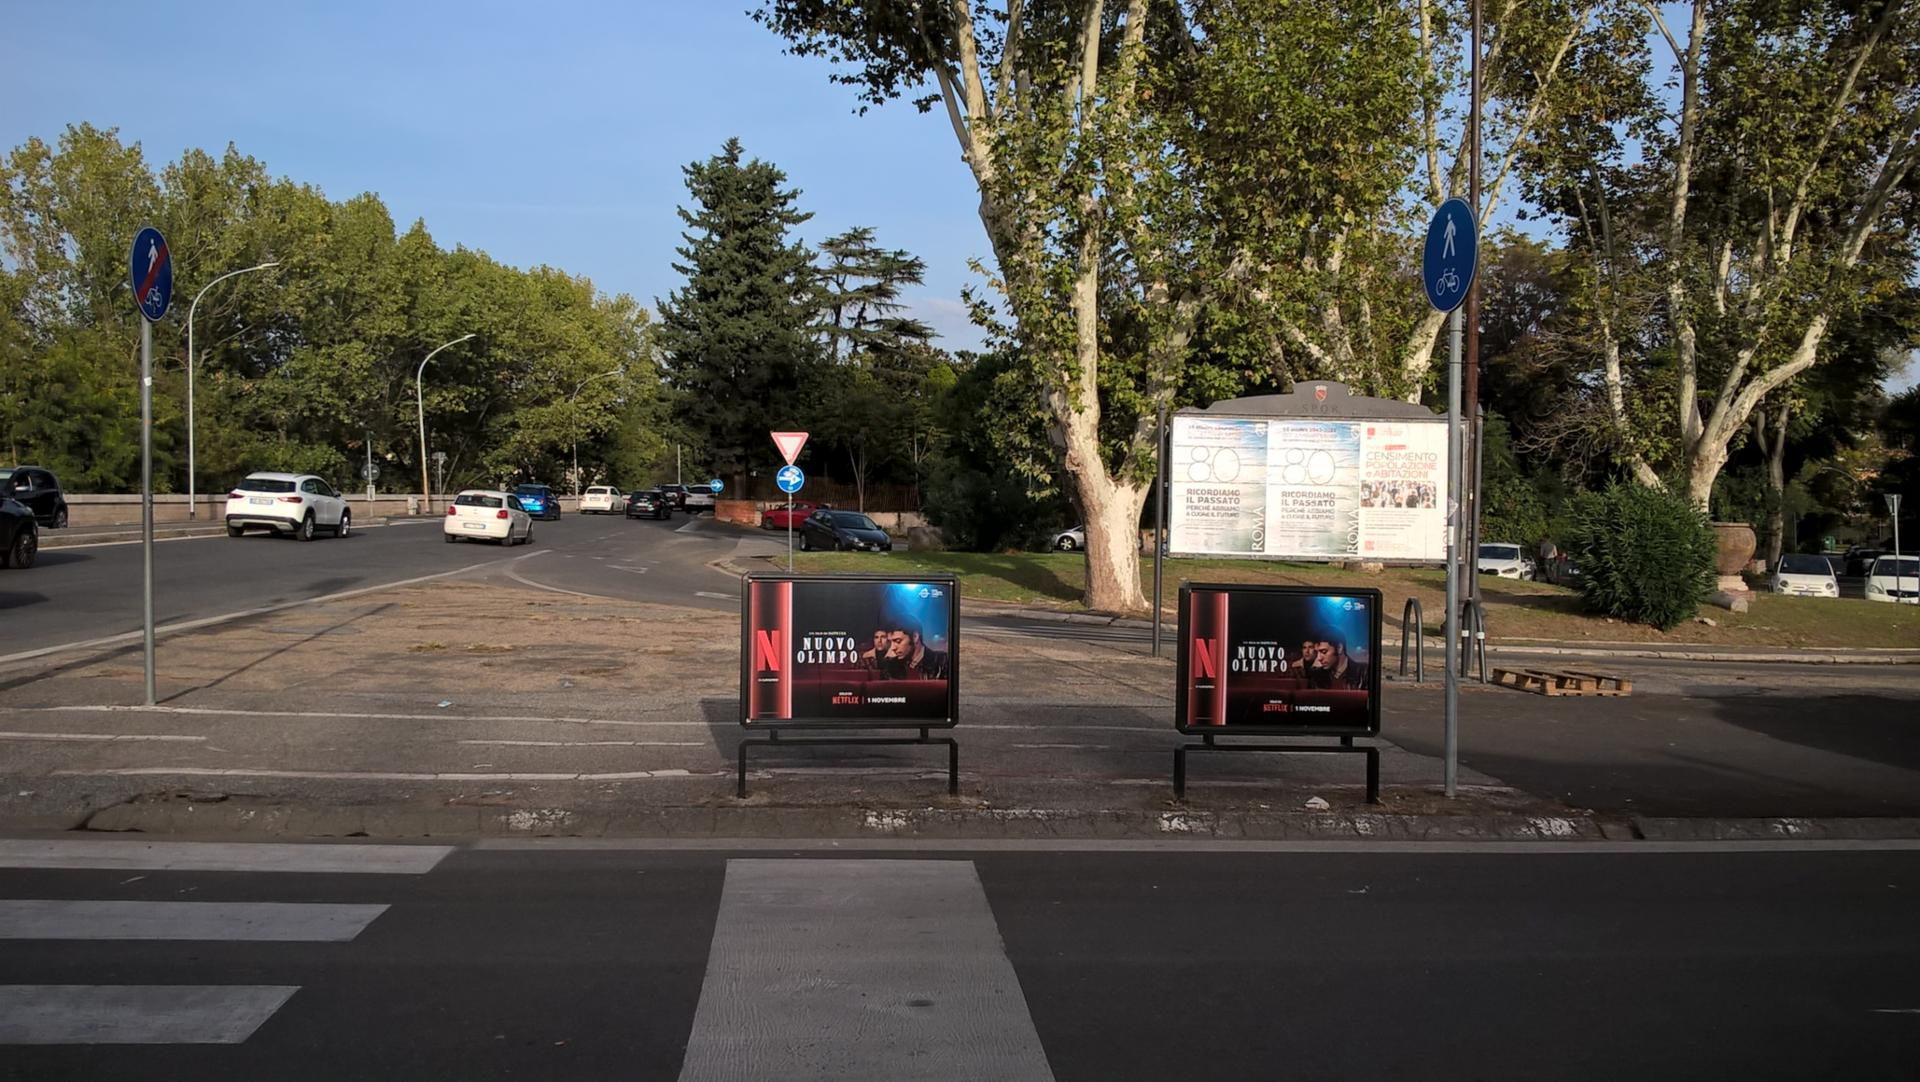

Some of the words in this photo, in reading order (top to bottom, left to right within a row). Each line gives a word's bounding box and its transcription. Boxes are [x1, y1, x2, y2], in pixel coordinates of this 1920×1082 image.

[1366, 452, 1438, 461] CENSIMENTO
[1366, 461, 1438, 470] POPOLAZIONE
[1374, 470, 1428, 478] ABITAZIONI
[1186, 488, 1240, 496] RICORDIAMO
[1281, 491, 1336, 499] RICORDIAMO
[1197, 496, 1240, 504] PASSATO
[1293, 499, 1336, 507] PASSATO
[1251, 506, 1264, 551] ROMA
[1347, 509, 1359, 554] ROMA
[803, 637, 856, 650] NUOVO
[757, 630, 780, 671] N
[1237, 646, 1285, 660] NUOVO
[797, 650, 858, 664] OLIMPO
[1194, 638, 1216, 678] N
[1231, 659, 1288, 673] OLIMPO
[832, 696, 859, 705] NETFLIX
[1263, 704, 1288, 712] NETFLIX
